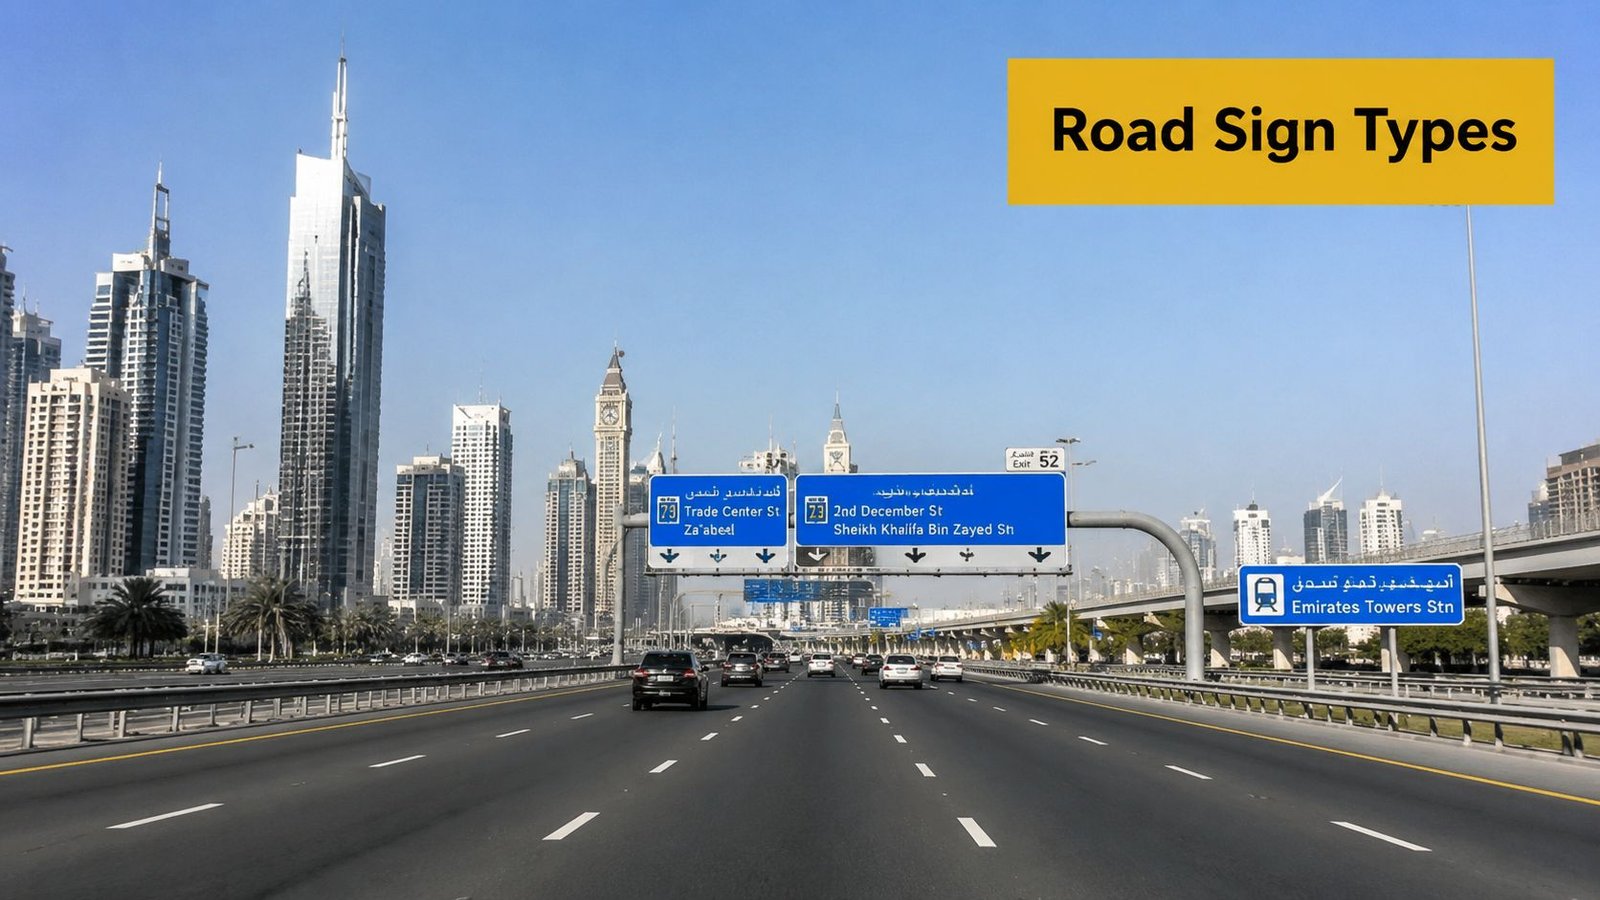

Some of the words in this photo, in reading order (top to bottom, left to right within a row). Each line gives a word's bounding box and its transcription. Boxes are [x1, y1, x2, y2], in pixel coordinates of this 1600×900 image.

[1012, 459, 1031, 469] Exit
[1039, 454, 1059, 468] 52
[684, 505, 719, 518] Trade
[723, 505, 763, 518] Center
[767, 505, 781, 518] St
[833, 504, 857, 517] 2nd
[861, 504, 925, 517] December
[929, 504, 944, 517] St
[834, 523, 878, 536] Sheikh
[881, 523, 925, 536] Khalifa
[928, 523, 949, 536] Bin
[953, 523, 994, 538] Zayed
[1292, 600, 1360, 614] Emirates
[1364, 600, 1422, 614] Towers
[1427, 600, 1454, 614] Stn
